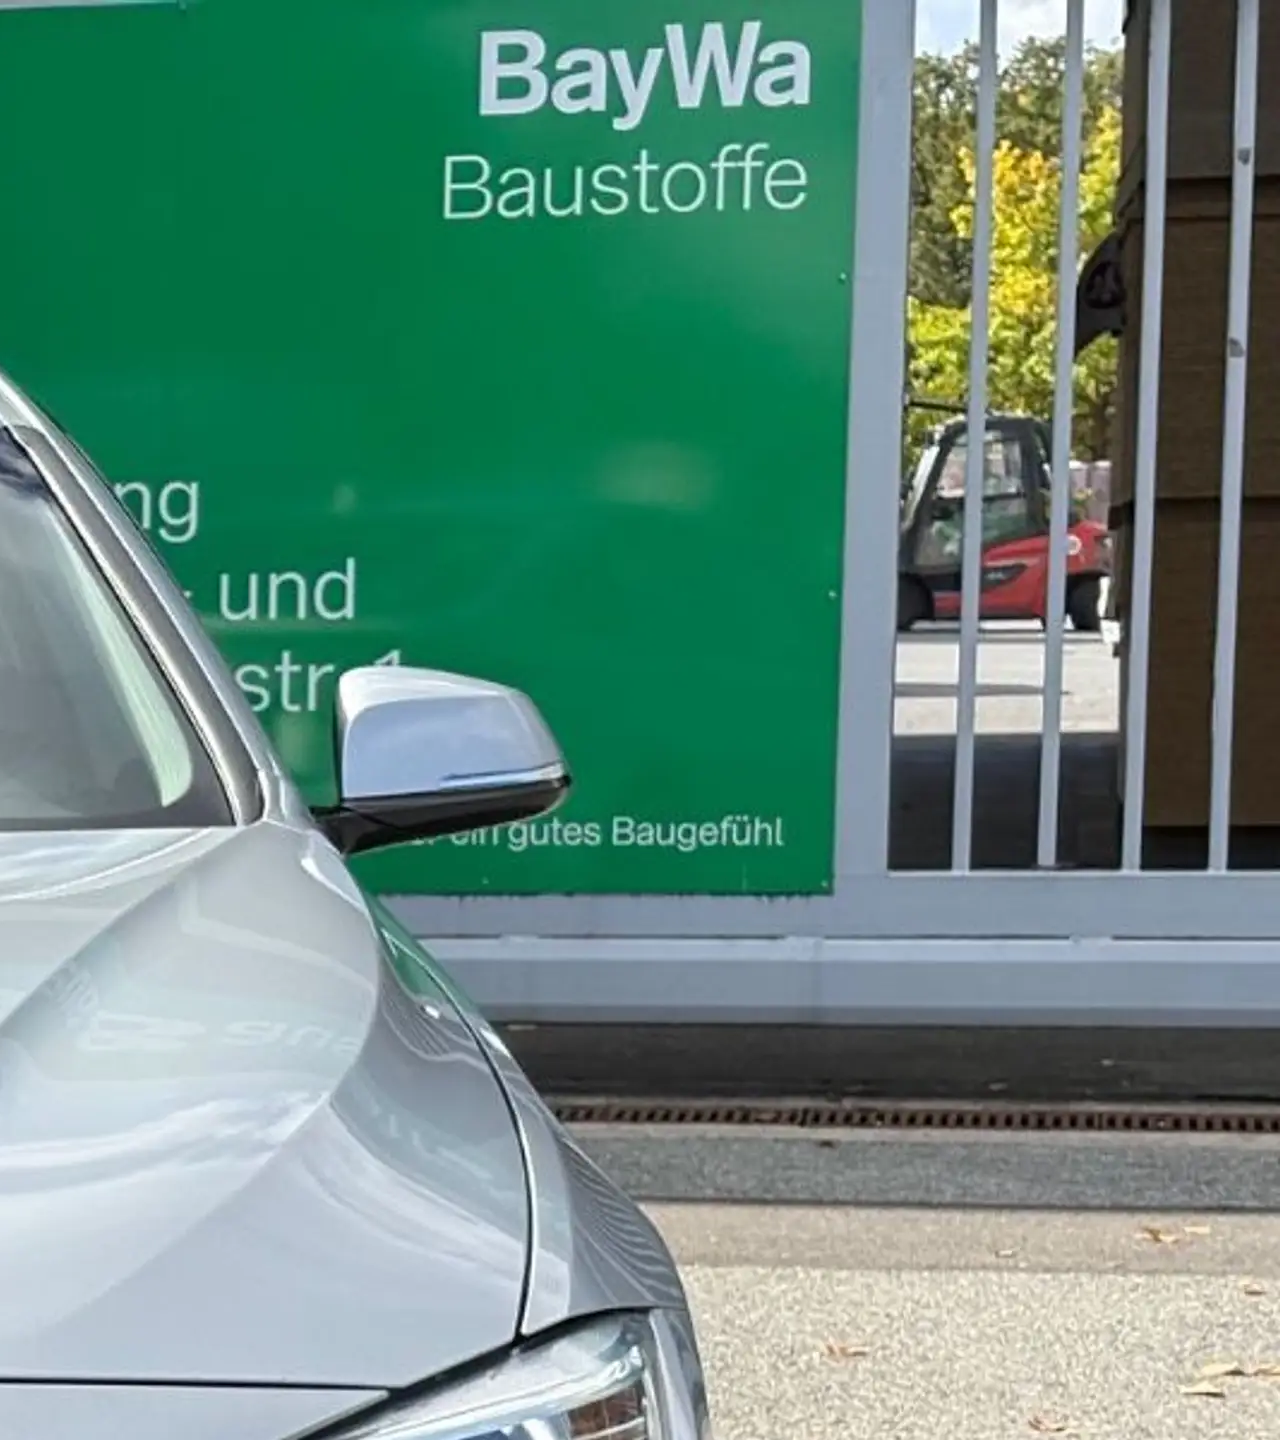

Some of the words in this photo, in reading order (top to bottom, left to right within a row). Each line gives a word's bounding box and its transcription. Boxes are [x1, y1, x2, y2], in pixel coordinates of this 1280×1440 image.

[479, 20, 811, 131] BayWa
[443, 142, 808, 220] Baustoffe
[218, 557, 356, 621] und
[235, 650, 336, 713] str
[507, 816, 602, 852] gutes
[611, 814, 785, 853] Baugefühl
